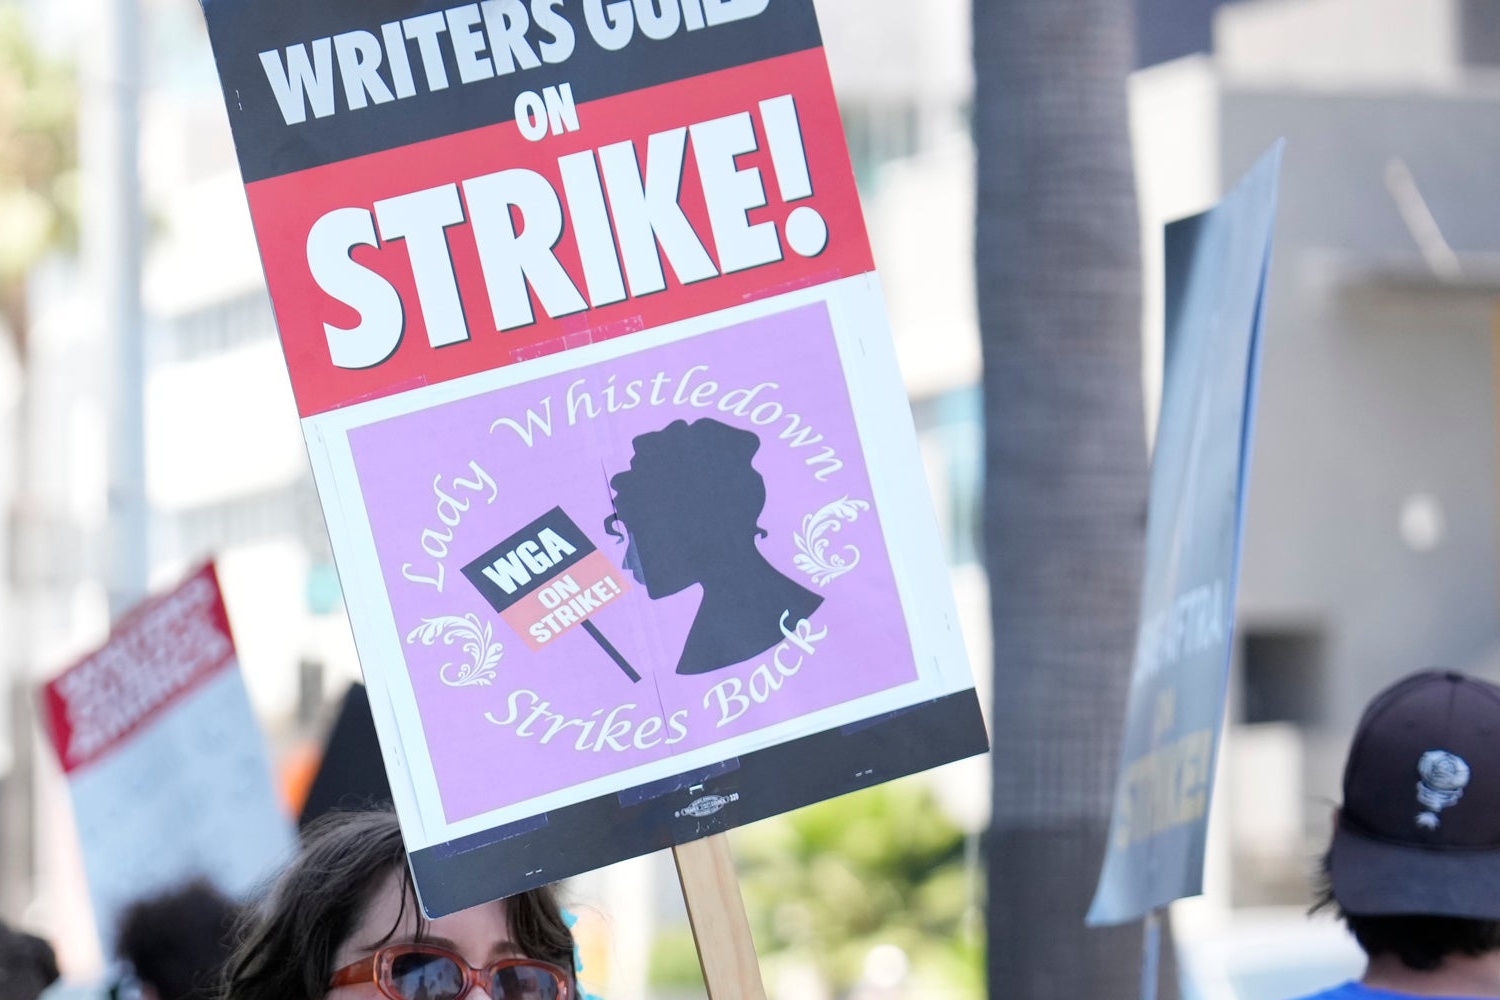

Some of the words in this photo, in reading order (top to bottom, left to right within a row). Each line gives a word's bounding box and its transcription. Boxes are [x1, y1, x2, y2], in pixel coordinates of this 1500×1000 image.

[258, 0, 576, 126] WRITERS
[514, 82, 580, 142] ON
[305, 93, 830, 369] STRIKE!
[402, 458, 499, 593] Lady
[489, 365, 844, 483] Whistledown
[481, 527, 577, 595] WGA
[528, 575, 622, 644] STRIKE!
[537, 574, 581, 610] ON
[484, 689, 688, 753] Strikes
[704, 609, 829, 728] Back
